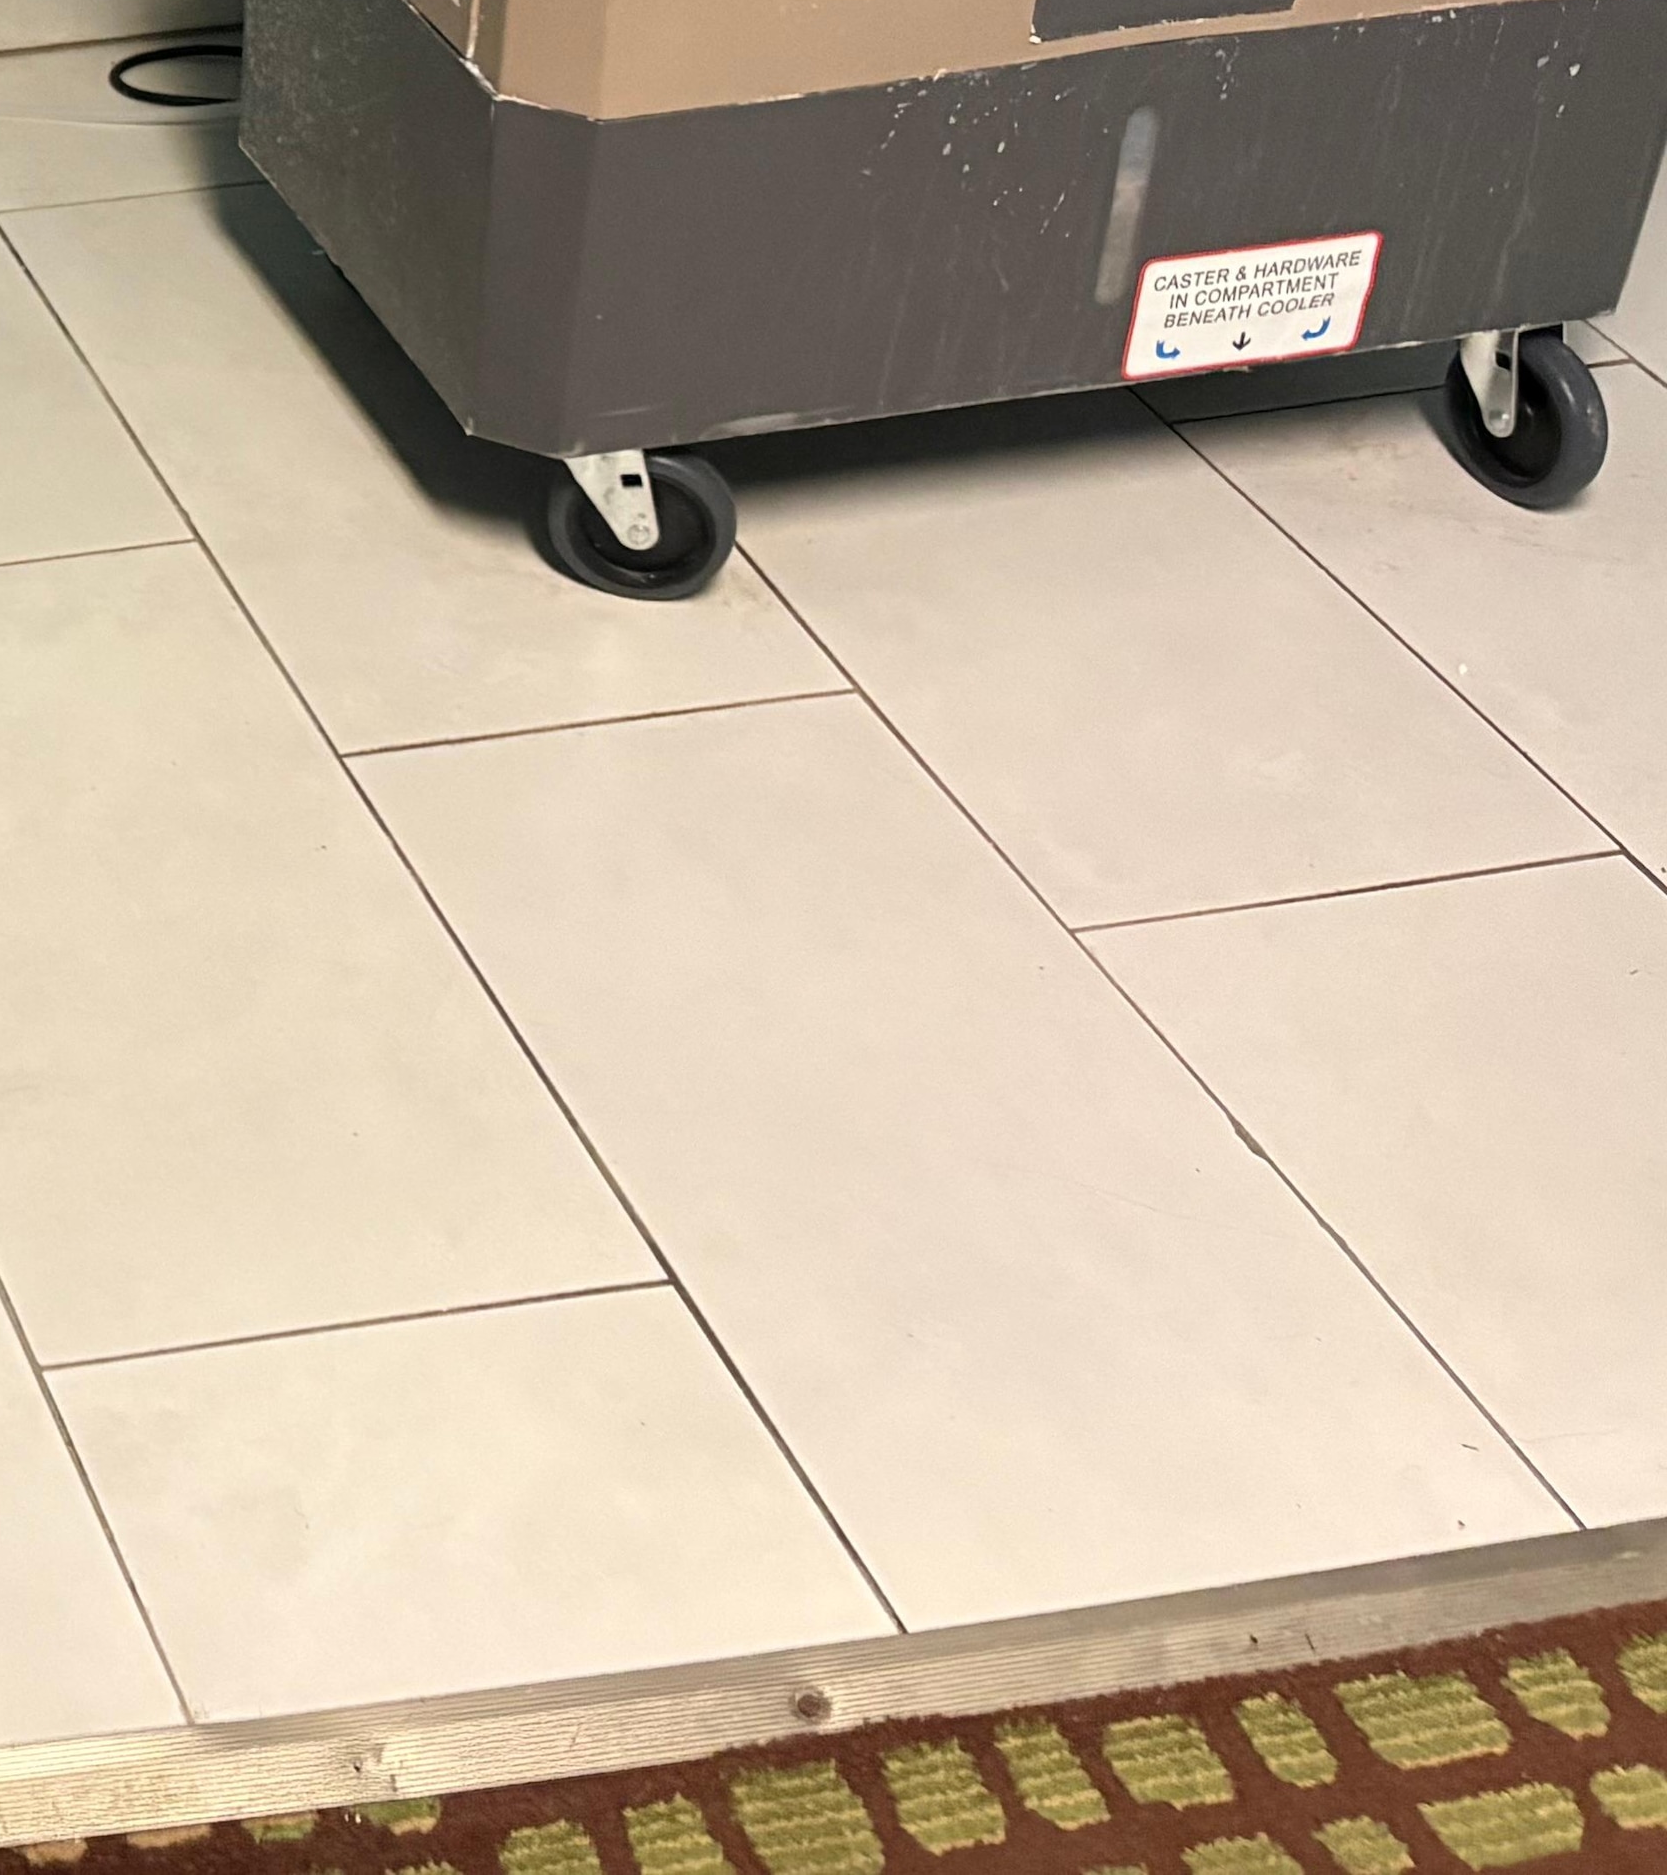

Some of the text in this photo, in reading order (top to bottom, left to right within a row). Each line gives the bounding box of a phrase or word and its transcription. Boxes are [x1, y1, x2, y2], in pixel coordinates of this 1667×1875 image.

[1154, 250, 1362, 291] CASTER & HARDWARE
[1169, 272, 1340, 309] IN COMPARTMENT
[1164, 292, 1335, 328] BENEATH COOLER
